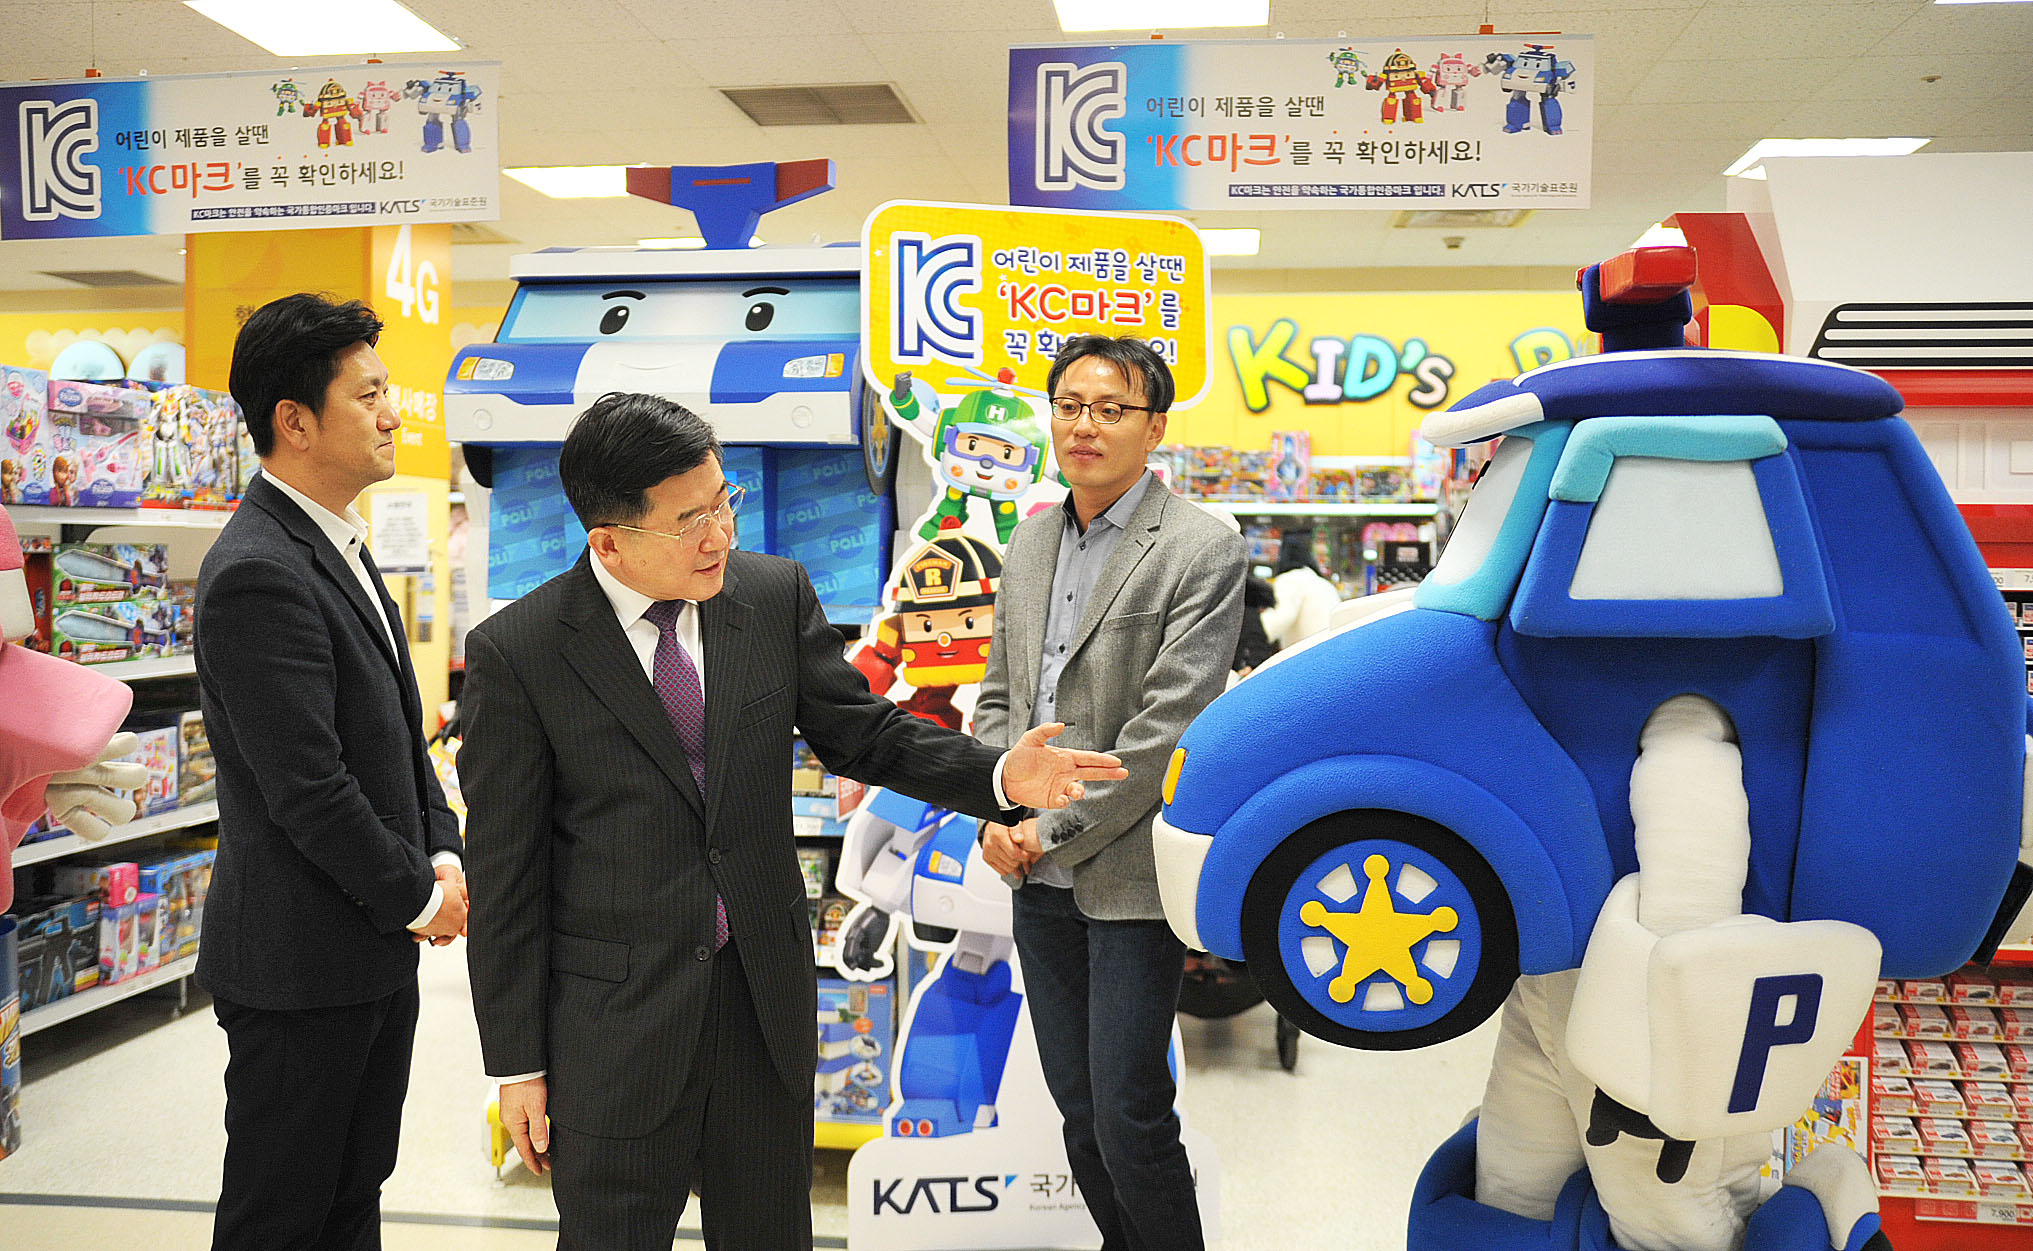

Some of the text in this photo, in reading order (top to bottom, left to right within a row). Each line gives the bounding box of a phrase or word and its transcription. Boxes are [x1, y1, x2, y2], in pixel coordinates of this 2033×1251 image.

[1146, 95, 1325, 118] 어린이 제품을 살땐
[116, 124, 270, 150] 어린이 제품을 살땐
[1323, 142, 1345, 164] 꼭
[1356, 140, 1481, 165] 확인하세요!
[270, 166, 290, 188] 꼭
[298, 160, 405, 187] 확인하세요!
[1451, 183, 1500, 198] KATS
[1511, 182, 1578, 193] 국가기술표준원
[380, 199, 421, 214] KATS
[994, 250, 1183, 281] 어린이 제품을 살땐
[1006, 332, 1027, 361] 꼭
[525, 463, 557, 481] POLI
[812, 462, 847, 480] POLI
[501, 508, 534, 527] POLI
[787, 506, 821, 526] POLI
[830, 534, 865, 553] POLI
[925, 568, 942, 586] R
[1728, 973, 1823, 1114] P
[874, 1175, 999, 1215] KATS
